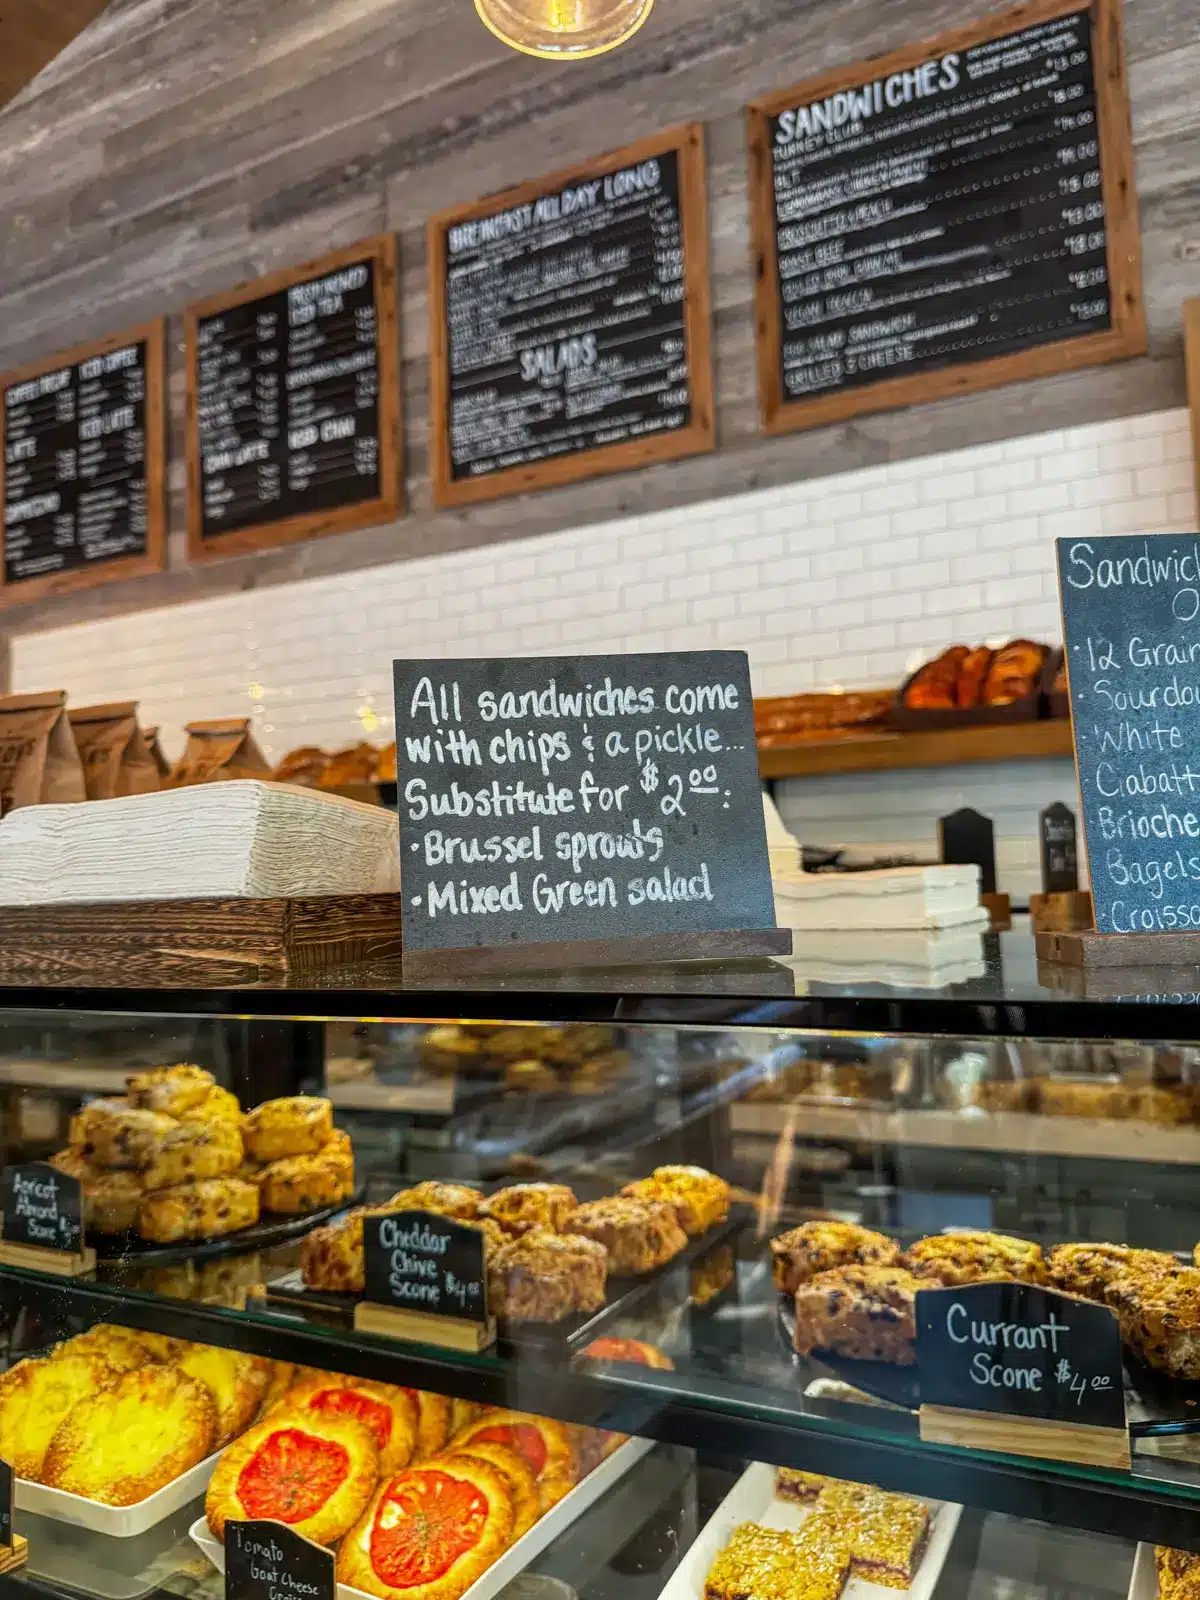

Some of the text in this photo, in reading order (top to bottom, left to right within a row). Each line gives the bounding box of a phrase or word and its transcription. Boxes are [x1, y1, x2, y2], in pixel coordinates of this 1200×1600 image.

[776, 54, 960, 145] SANDWICHES
[825, 121, 864, 144] CLUB
[848, 312, 916, 343] SANDWICH
[519, 333, 598, 382] SALADS
[858, 343, 915, 371] CHEESE
[1087, 637, 1121, 672] 12
[410, 676, 739, 725] All sandwiches come
[405, 730, 482, 765] with
[489, 729, 571, 775] chips
[605, 731, 629, 757] a
[1094, 719, 1184, 753] White
[404, 778, 574, 820] Substitute
[579, 771, 629, 813] for
[424, 819, 663, 873] Brussel sprouts
[428, 863, 714, 918] Mixed Green salad
[380, 1218, 451, 1254] Cheddar
[390, 1249, 438, 1279] Chive
[389, 1272, 440, 1304] Scone
[947, 1303, 1070, 1353] Currant
[969, 1352, 1043, 1392] Scone
[232, 1526, 283, 1561] Tomato
[250, 1560, 320, 1595] Goat Cheese
